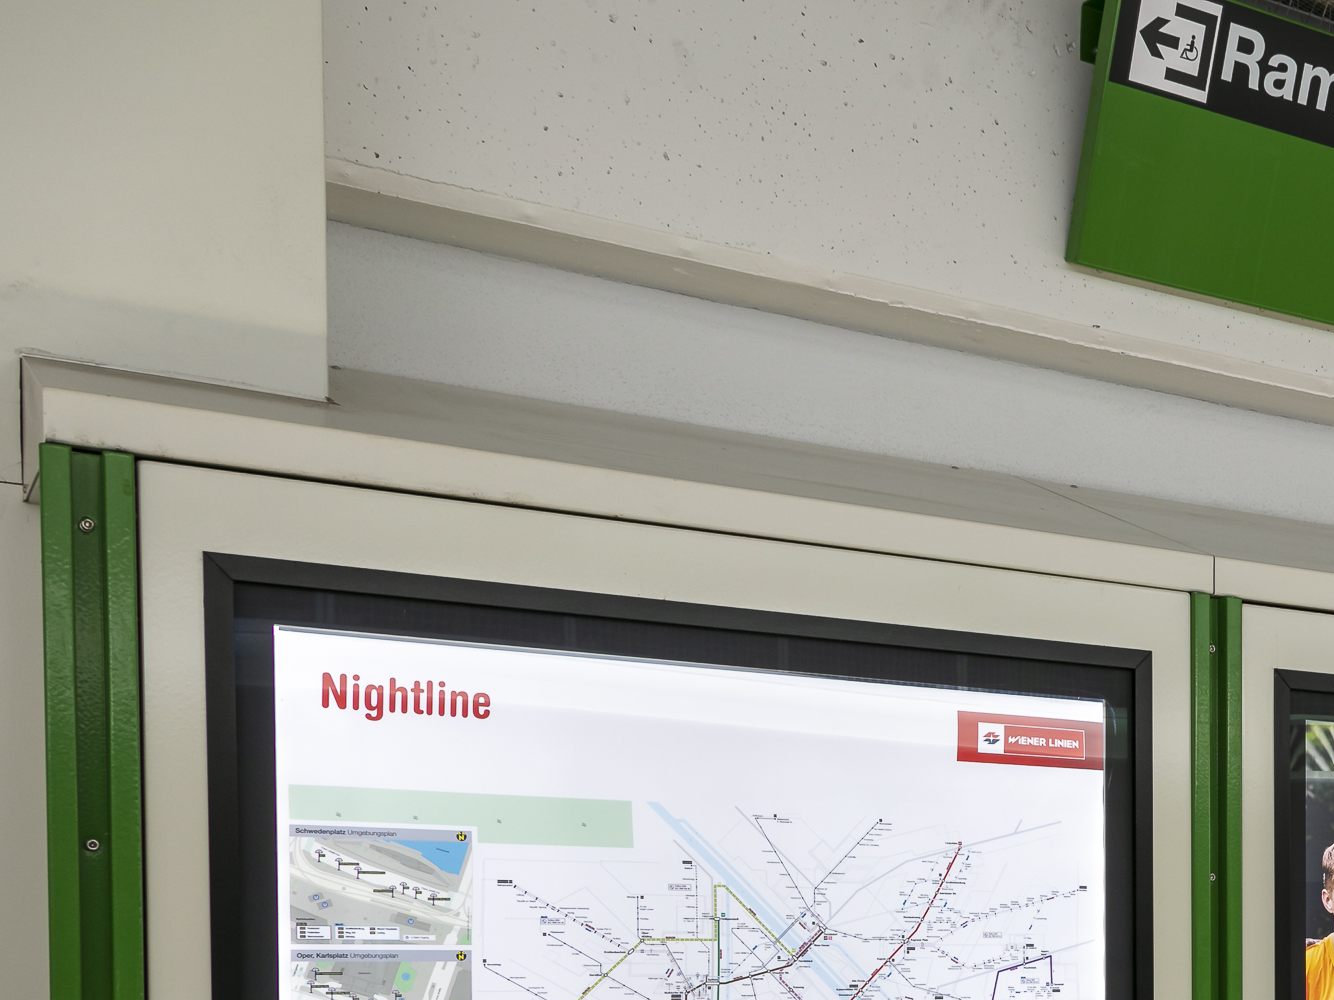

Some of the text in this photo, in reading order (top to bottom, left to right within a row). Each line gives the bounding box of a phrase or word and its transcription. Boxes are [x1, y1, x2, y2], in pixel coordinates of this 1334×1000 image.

[321, 671, 491, 722] Nightline
[1008, 735, 1079, 749] WIENER LINIEN
[295, 827, 346, 836] Schwedenplatz
[316, 952, 349, 960] Karlsplatz
